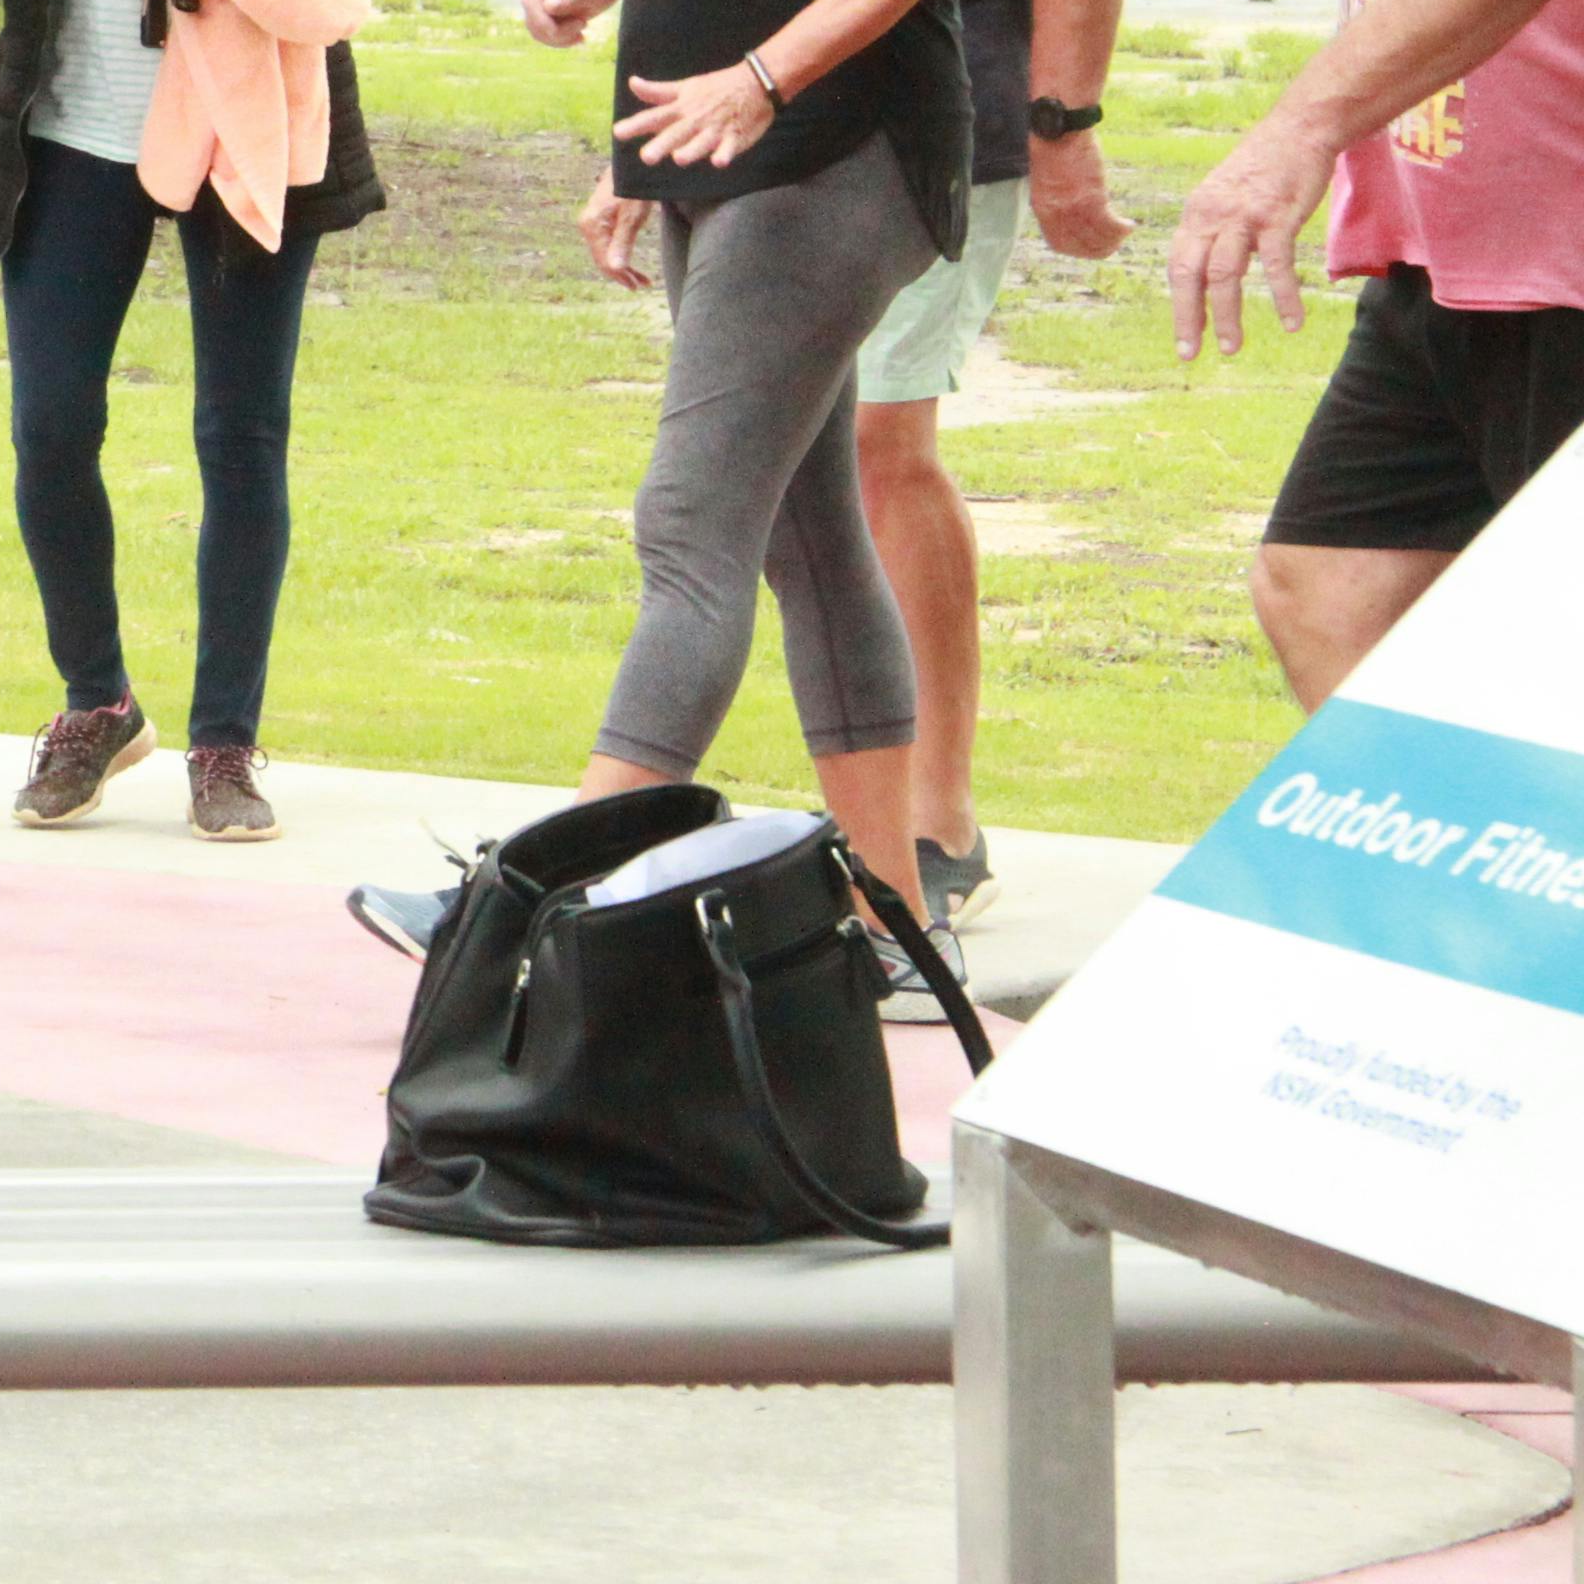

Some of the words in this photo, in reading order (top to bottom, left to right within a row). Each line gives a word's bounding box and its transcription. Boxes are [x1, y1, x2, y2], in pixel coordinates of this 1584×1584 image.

[1256, 771, 1469, 867] Outdoor
[1448, 820, 1584, 910] Fitne
[1261, 1070, 1327, 1106] NSW
[1319, 1087, 1465, 1154] Government
[1275, 1024, 1359, 1077] Proudly
[1364, 1050, 1452, 1100] funded
[1440, 1076, 1479, 1114] by
[1476, 1089, 1523, 1122] the
